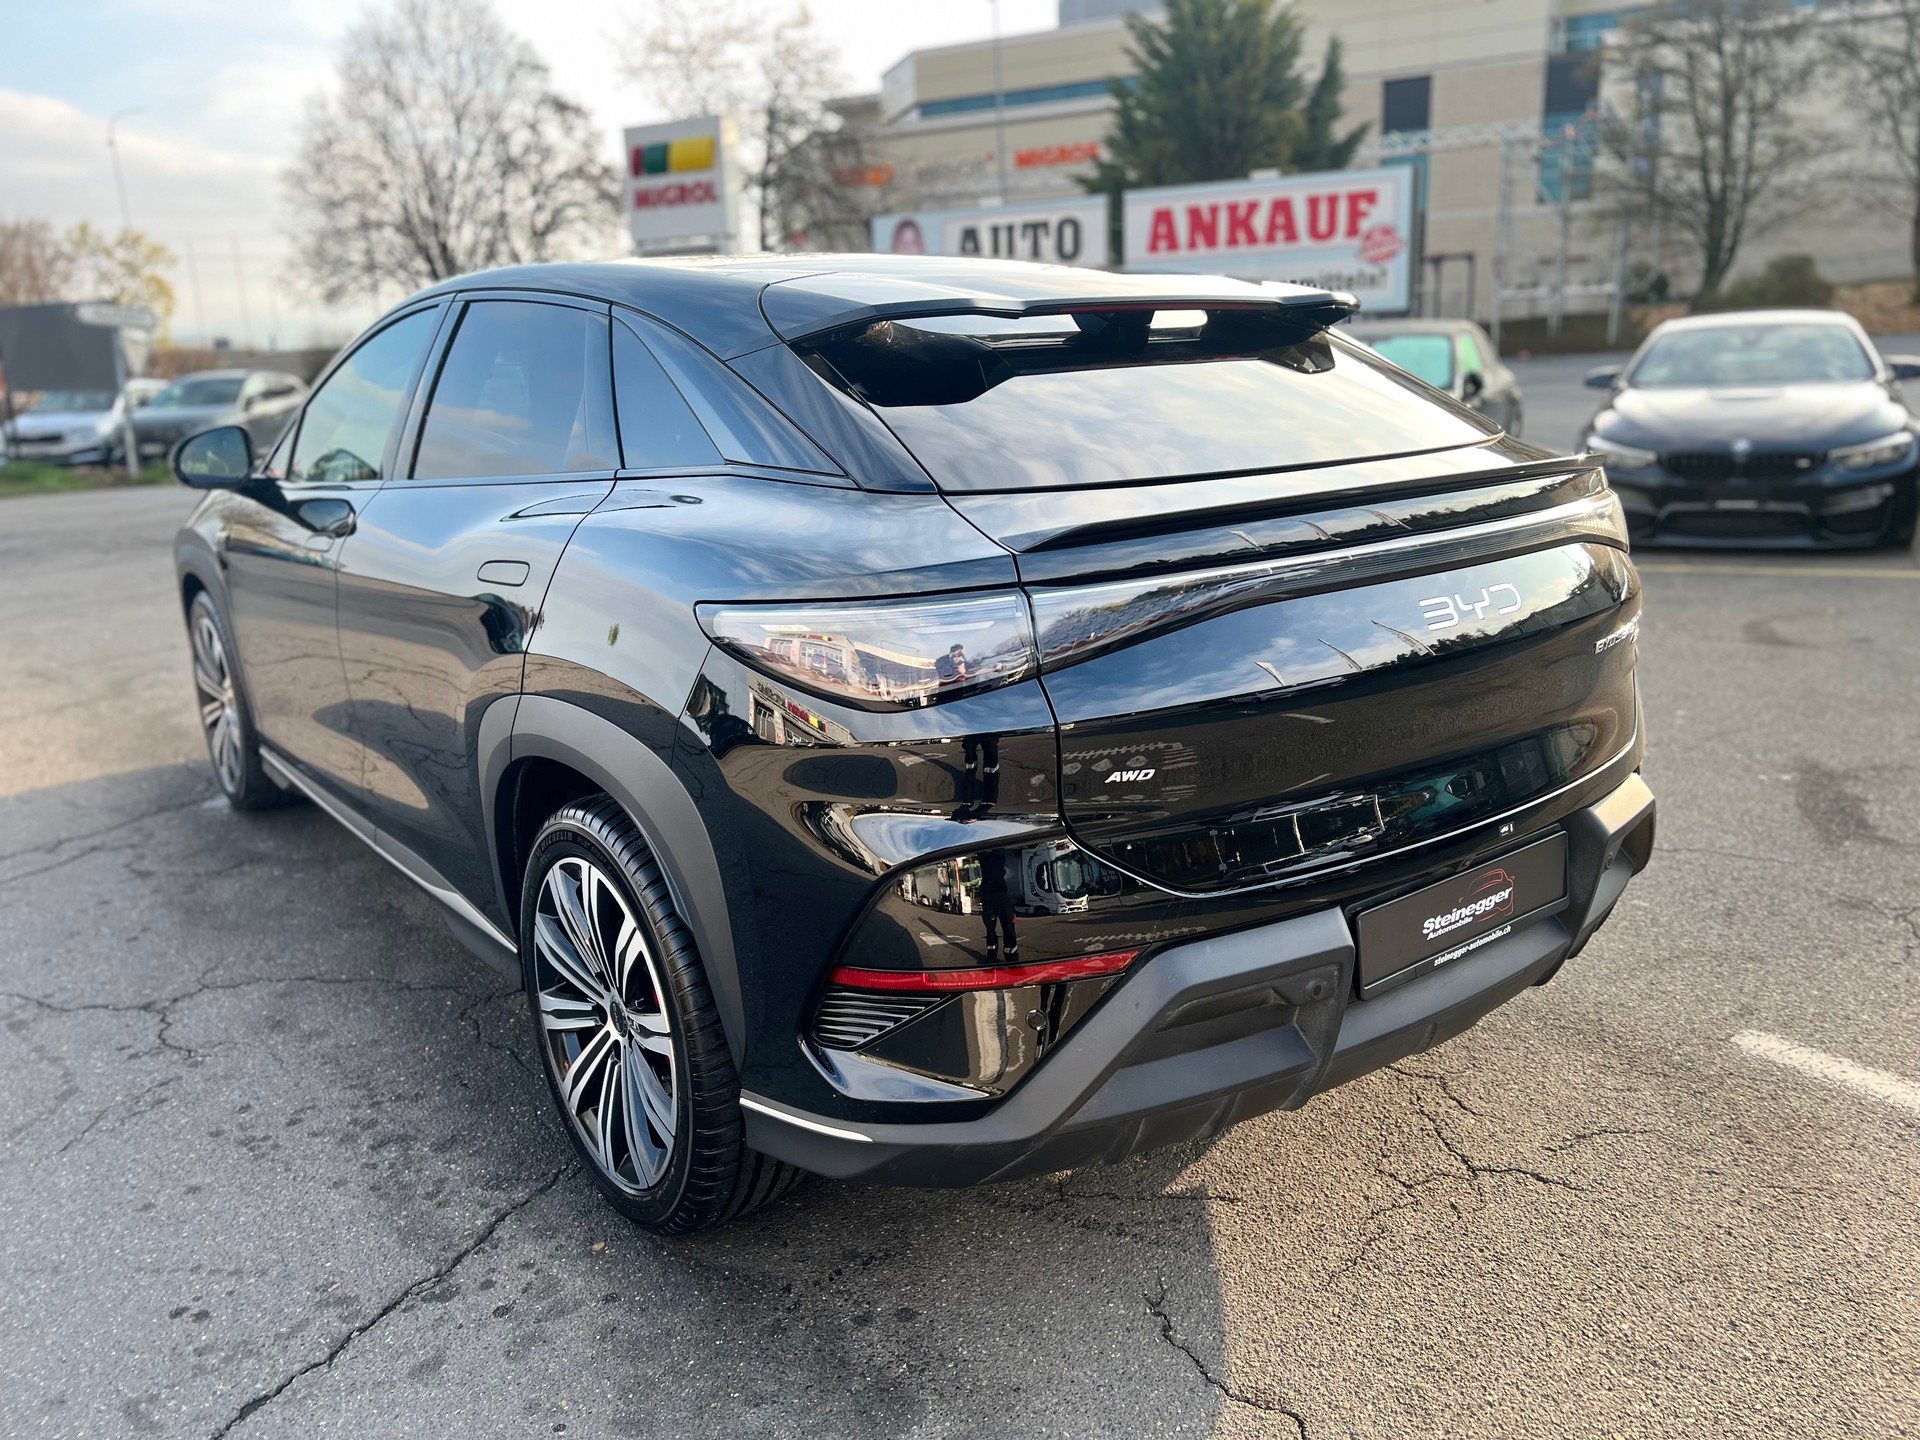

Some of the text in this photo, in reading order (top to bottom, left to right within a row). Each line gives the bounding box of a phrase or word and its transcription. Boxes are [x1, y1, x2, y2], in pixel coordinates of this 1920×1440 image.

[959, 217, 1082, 262] AUTO
[1147, 189, 1380, 254] ANKAUF
[1418, 582, 1522, 631] BYD
[1104, 768, 1156, 783] AWD
[1422, 887, 1513, 934] Steinegger
[1426, 915, 1474, 940] Automobile
[1433, 924, 1512, 967] steinegger-automobile.ch
